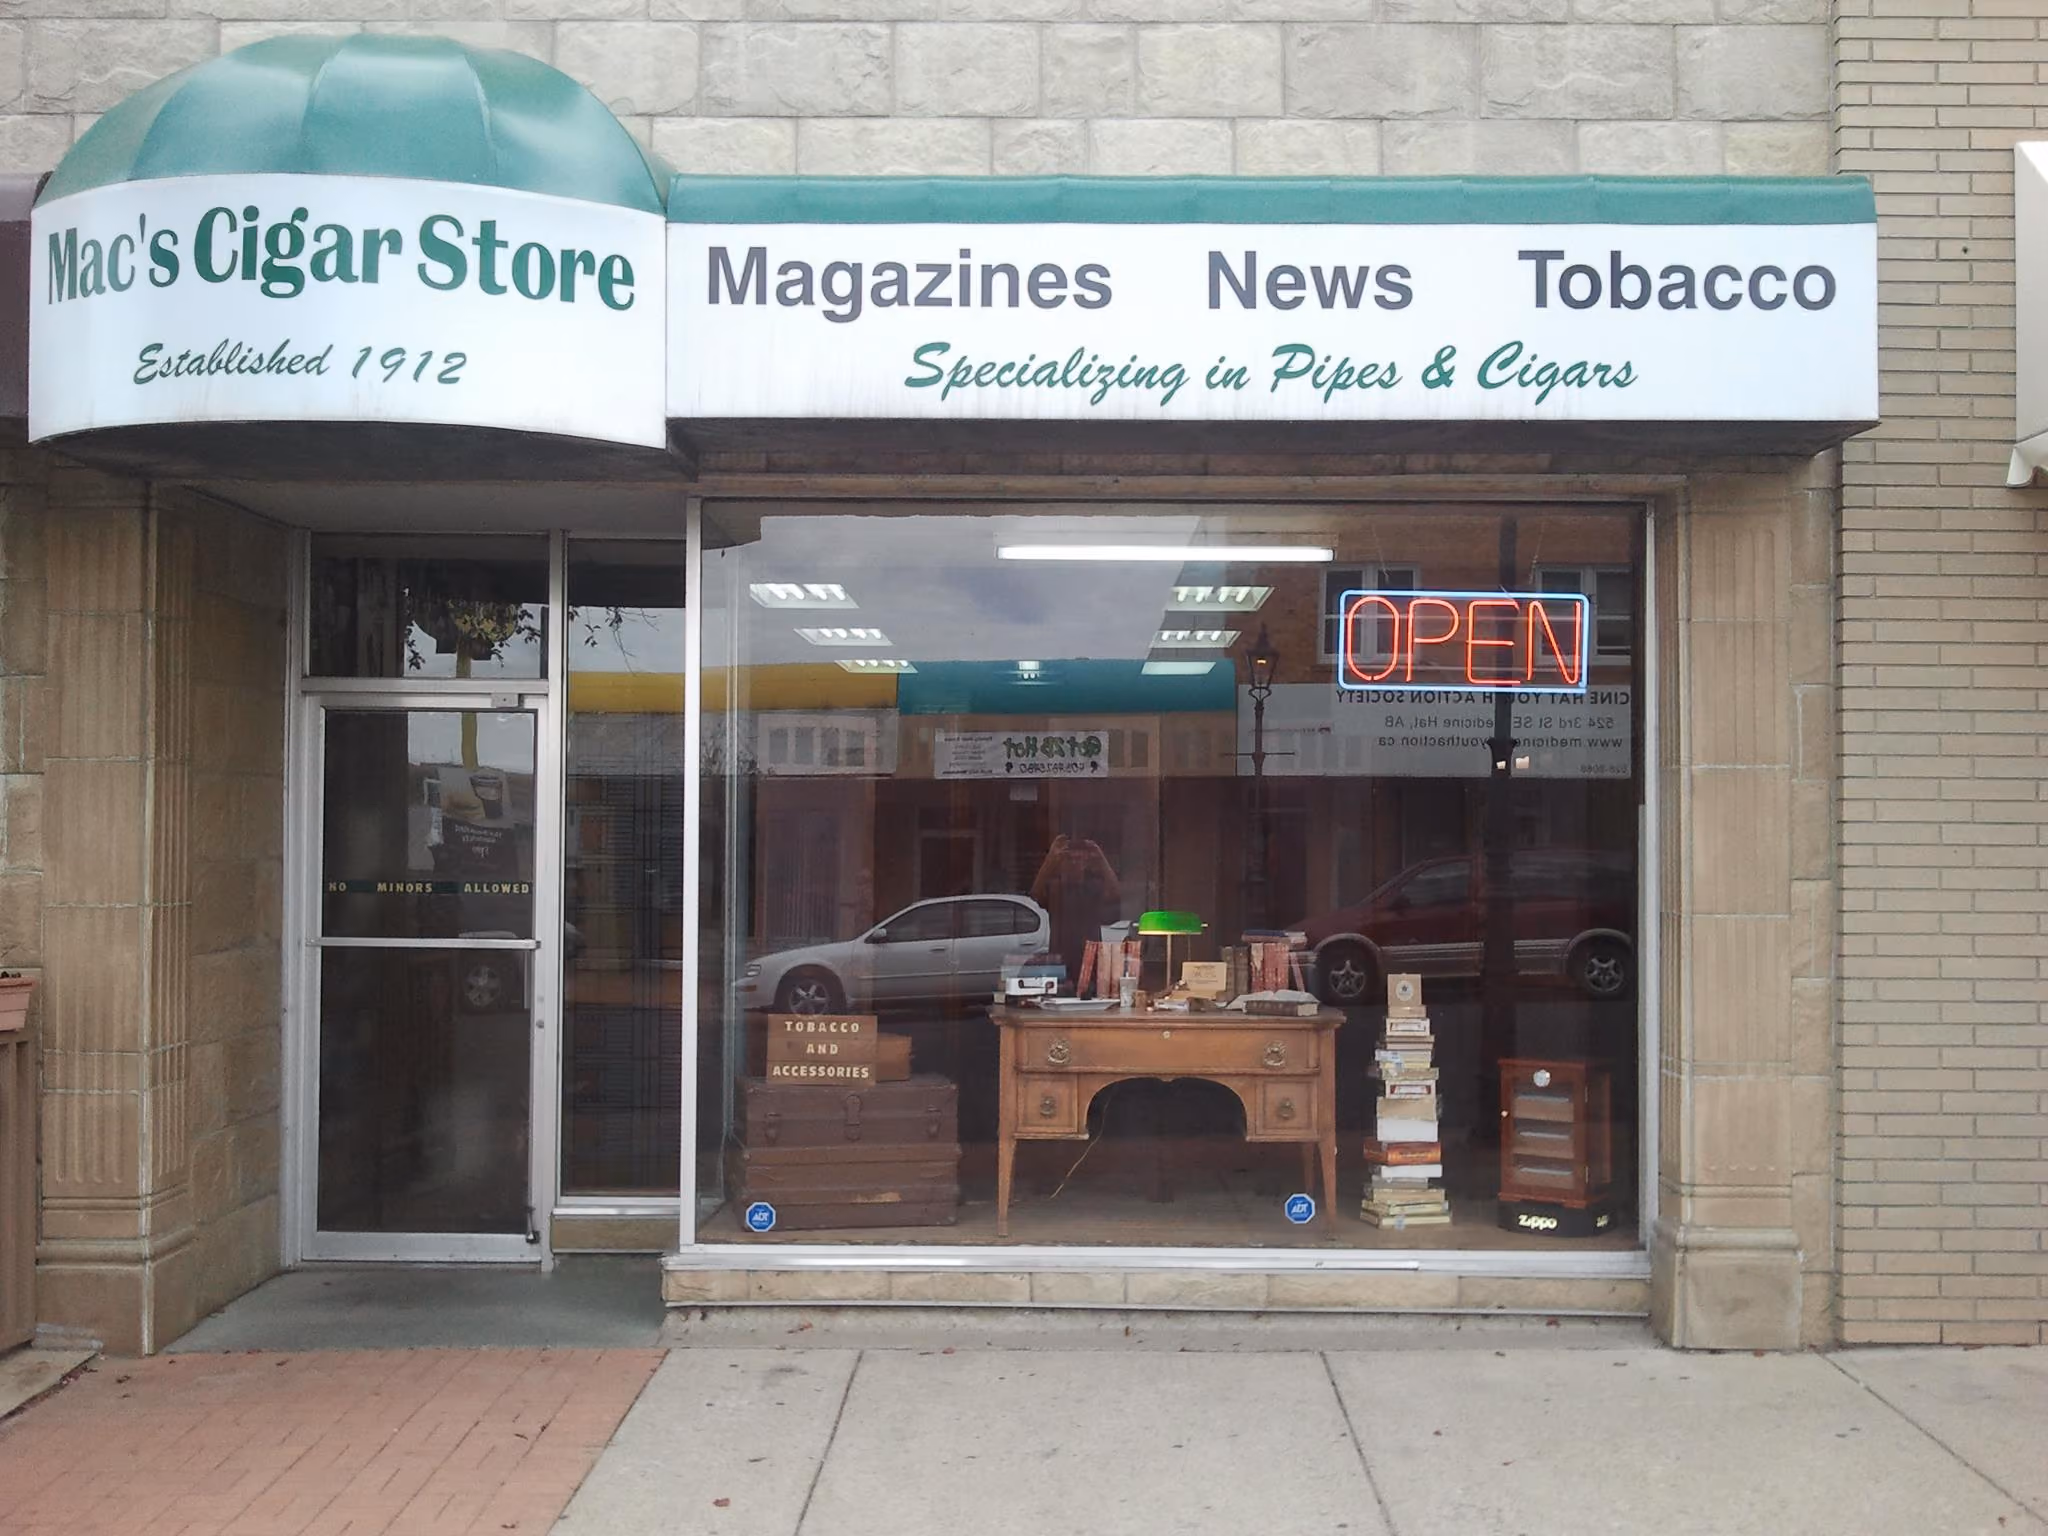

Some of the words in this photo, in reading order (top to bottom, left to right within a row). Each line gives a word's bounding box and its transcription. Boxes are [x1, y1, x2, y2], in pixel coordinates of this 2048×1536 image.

[48, 213, 180, 305] Mac's
[194, 205, 403, 299] Cigar
[417, 213, 635, 311] Store
[708, 246, 1113, 323] Magazines
[1208, 250, 1413, 310] News
[1518, 250, 1836, 311] Tobacco
[133, 338, 334, 385] Established
[351, 345, 468, 385] 1912
[904, 342, 1191, 407] Specializing
[1205, 356, 1251, 391] in
[1270, 343, 1404, 404] Pipes
[1420, 344, 1457, 390] &
[1477, 341, 1639, 406] Cigars
[1345, 596, 1582, 685] OPEN
[328, 882, 347, 892] NO
[376, 882, 433, 893] MINORS
[464, 882, 530, 894] ALLOWED
[785, 1021, 860, 1033] TOBACCO
[806, 1043, 839, 1055] AND
[772, 1065, 870, 1079] ACCESSORIES
